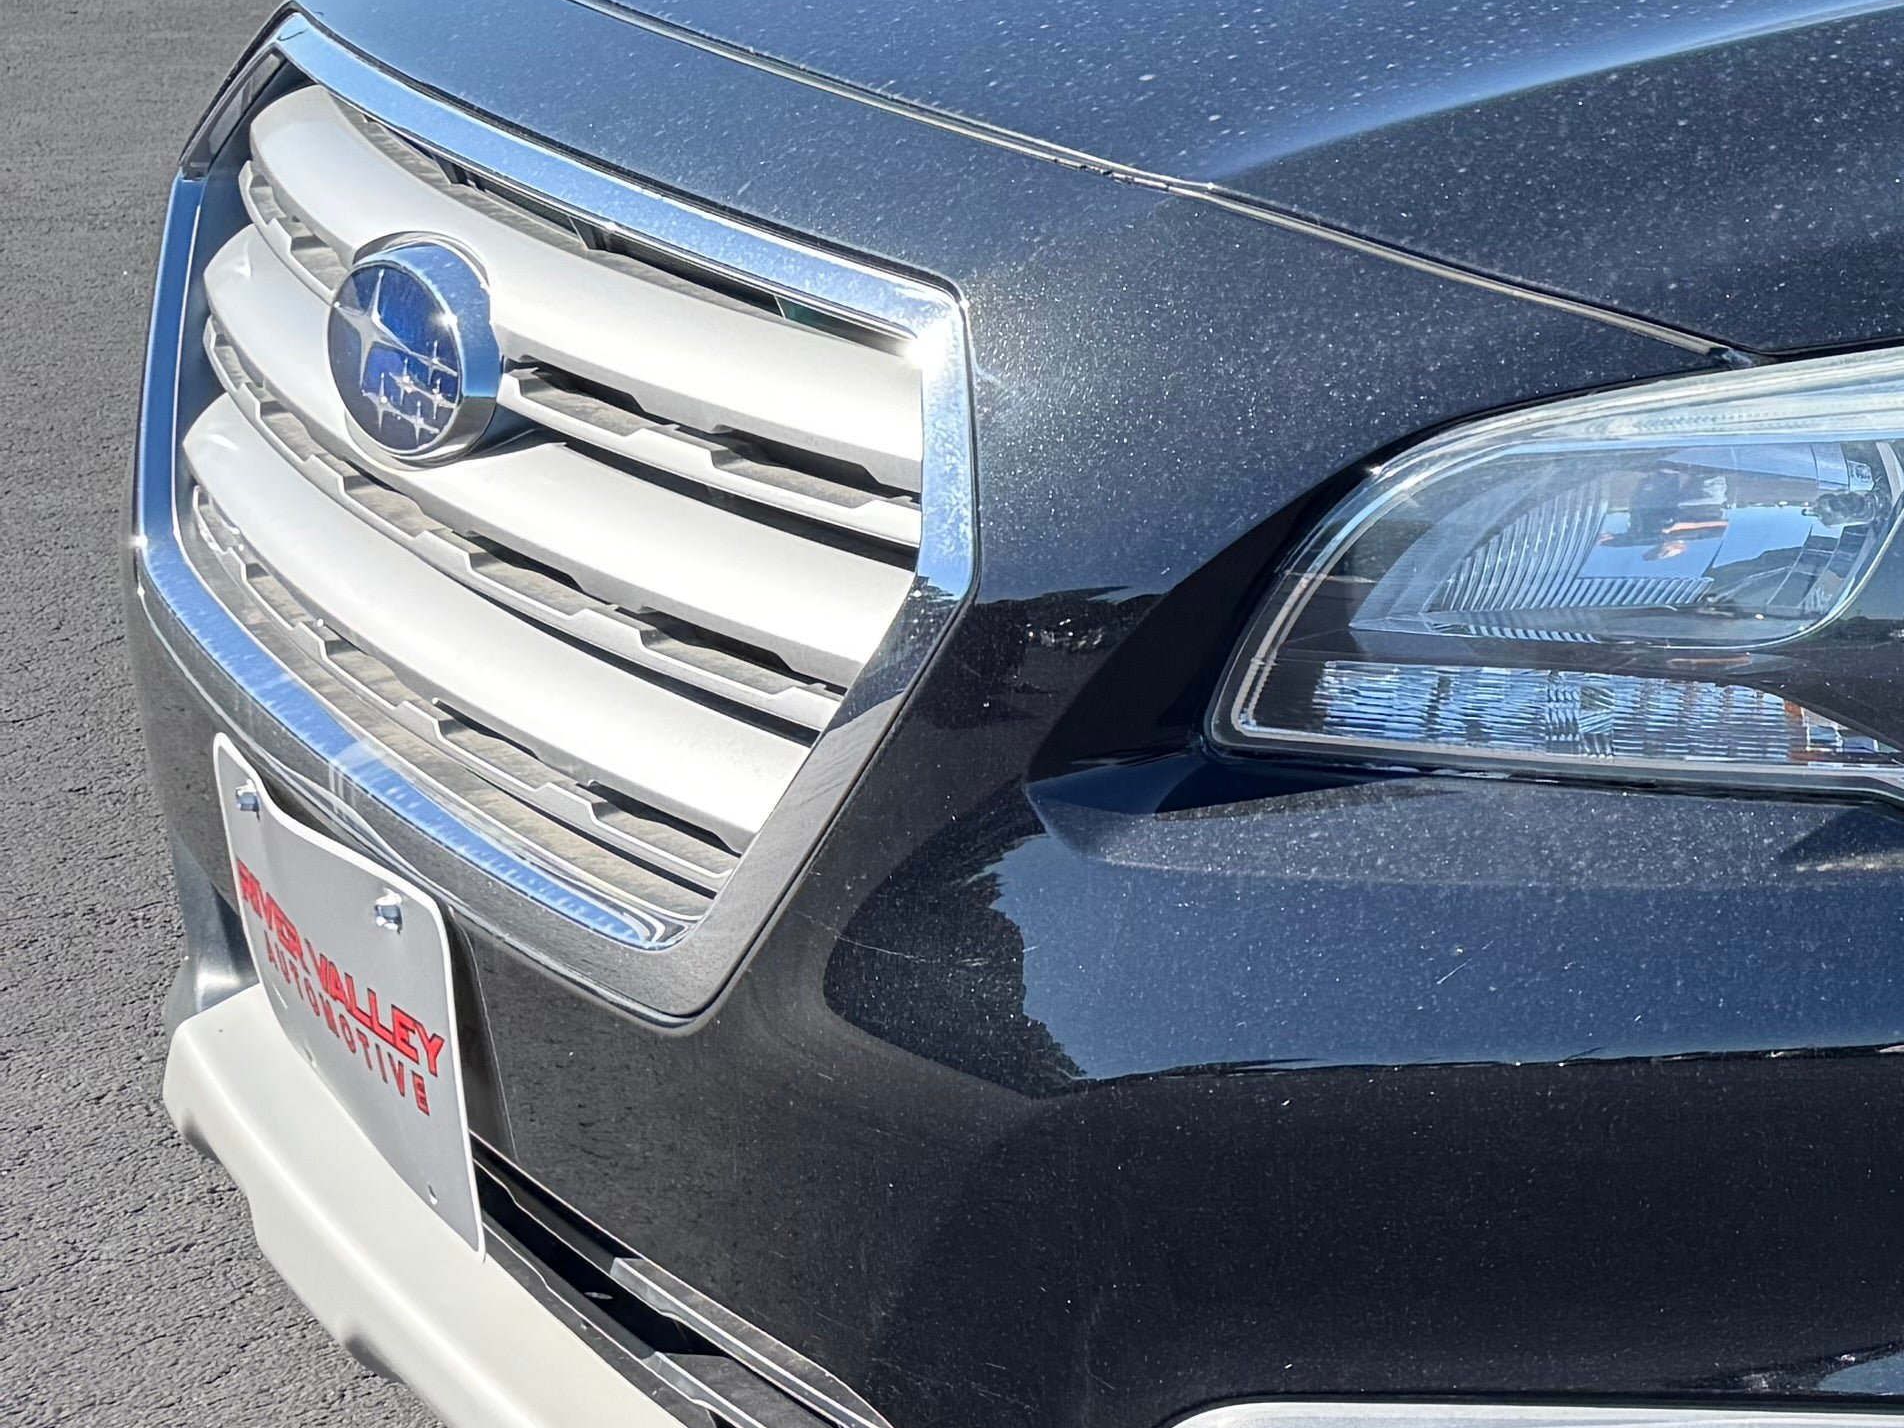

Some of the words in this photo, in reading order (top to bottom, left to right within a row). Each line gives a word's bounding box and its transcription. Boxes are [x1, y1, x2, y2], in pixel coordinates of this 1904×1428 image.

[235, 857, 311, 976] RIVER
[304, 937, 446, 1078] VALLEY
[263, 929, 430, 1117] AUTOMOTIVE
